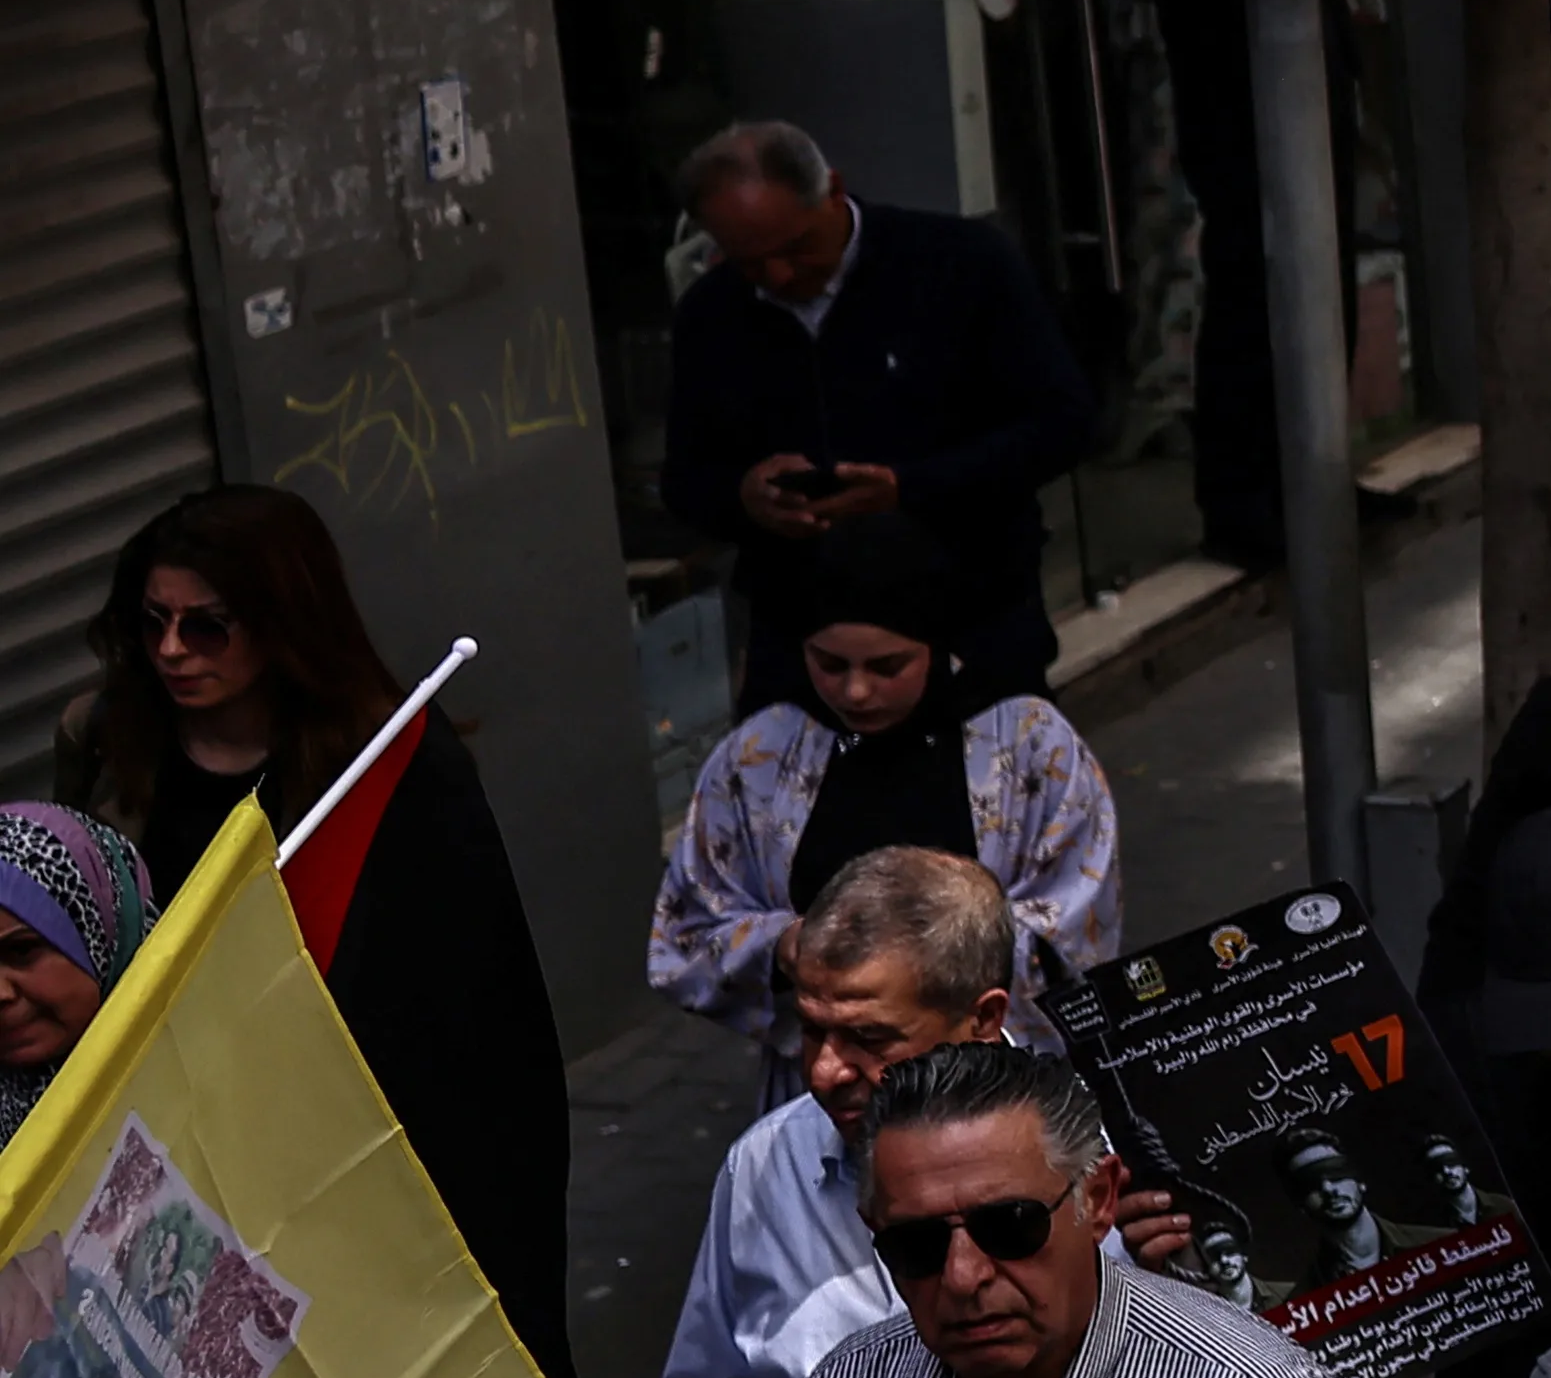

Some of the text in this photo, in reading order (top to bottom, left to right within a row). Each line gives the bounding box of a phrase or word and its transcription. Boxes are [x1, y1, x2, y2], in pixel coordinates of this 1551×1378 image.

[1308, 960, 1366, 992] مؤسسات
[1165, 1014, 1220, 1046] الوطنية
[1236, 1009, 1295, 1040] محافظة
[1295, 998, 1319, 1024] في
[1246, 1043, 1331, 1102] نيسان
[1329, 1012, 1407, 1093] 17
[1195, 1100, 1283, 1172] الفلسطيني
[1440, 1222, 1514, 1268] فليسقط
[1385, 1252, 1438, 1298] قانون
[1485, 1271, 1507, 1294] يوم
[1323, 1274, 1386, 1326] إعدام
[1389, 1289, 1450, 1333] الفلسطيني
[1420, 1310, 1455, 1338] قانون
